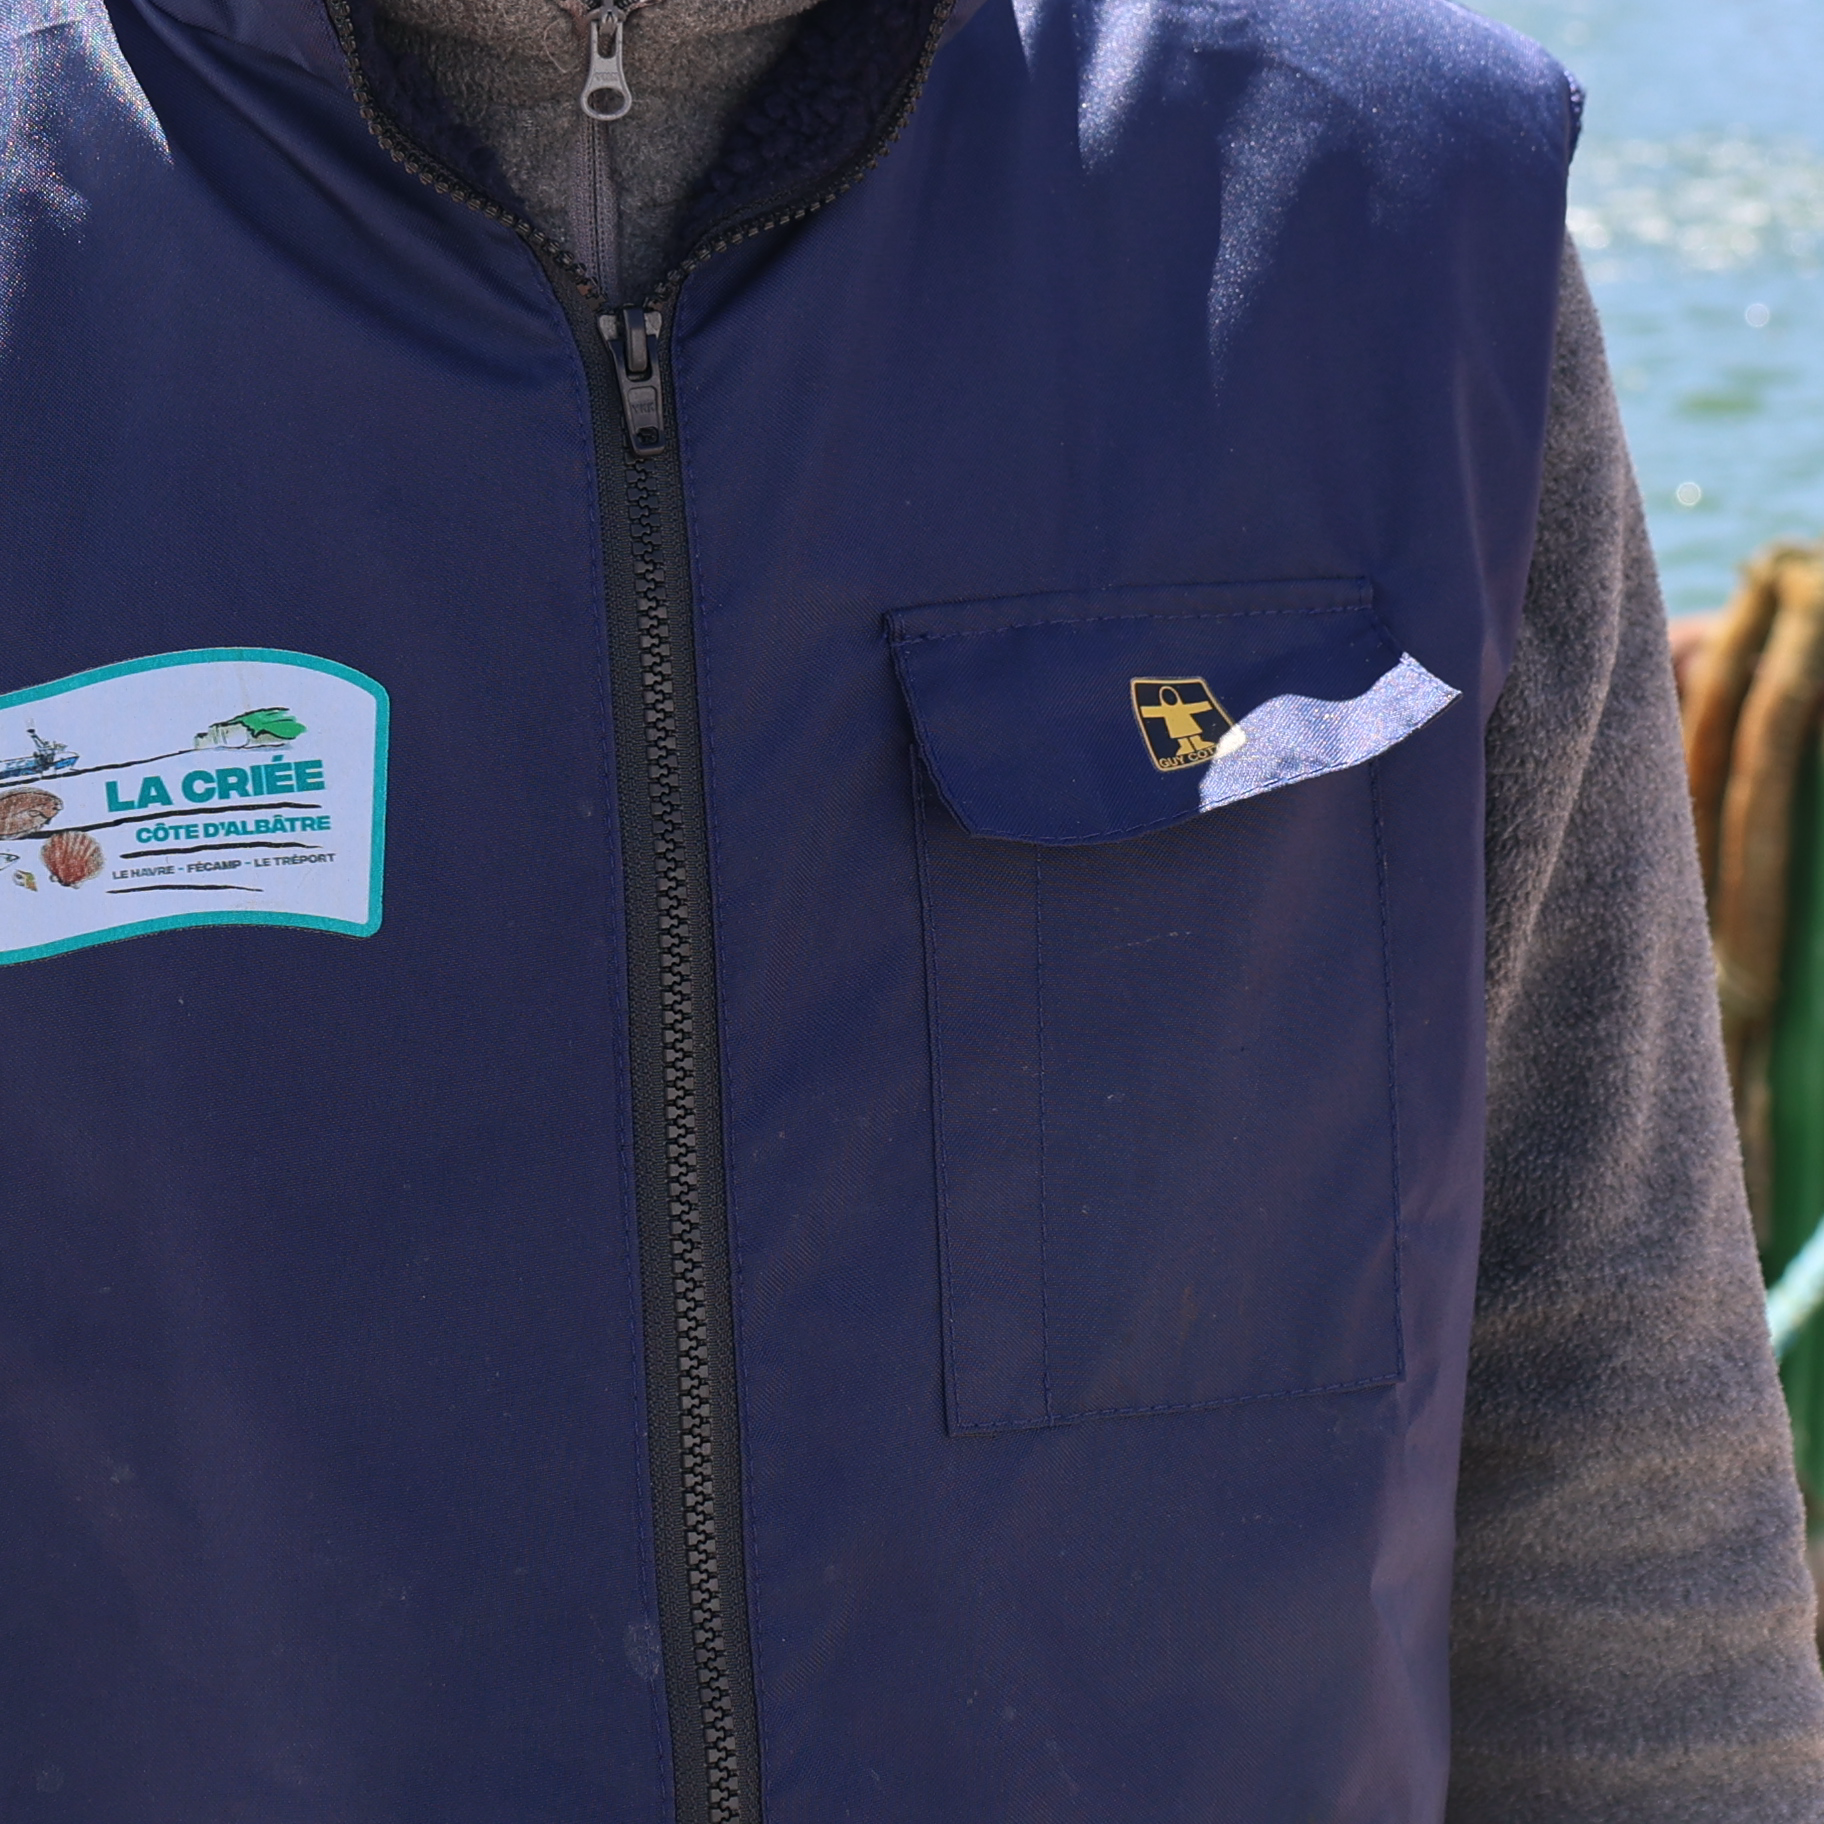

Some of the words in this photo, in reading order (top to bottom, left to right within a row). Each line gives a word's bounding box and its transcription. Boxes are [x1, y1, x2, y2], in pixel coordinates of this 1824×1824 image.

[1159, 756, 1184, 767] GUY
[105, 776, 173, 812] LA
[181, 755, 325, 803] CRIÉE
[136, 822, 199, 843] CÔTE
[204, 815, 331, 838] D'ALBÂTRE
[112, 870, 129, 880] LE
[131, 866, 175, 877] HAVRE
[187, 860, 242, 873] FÉCAMP
[254, 858, 272, 868] LE
[272, 853, 336, 866] TRÉPORT
